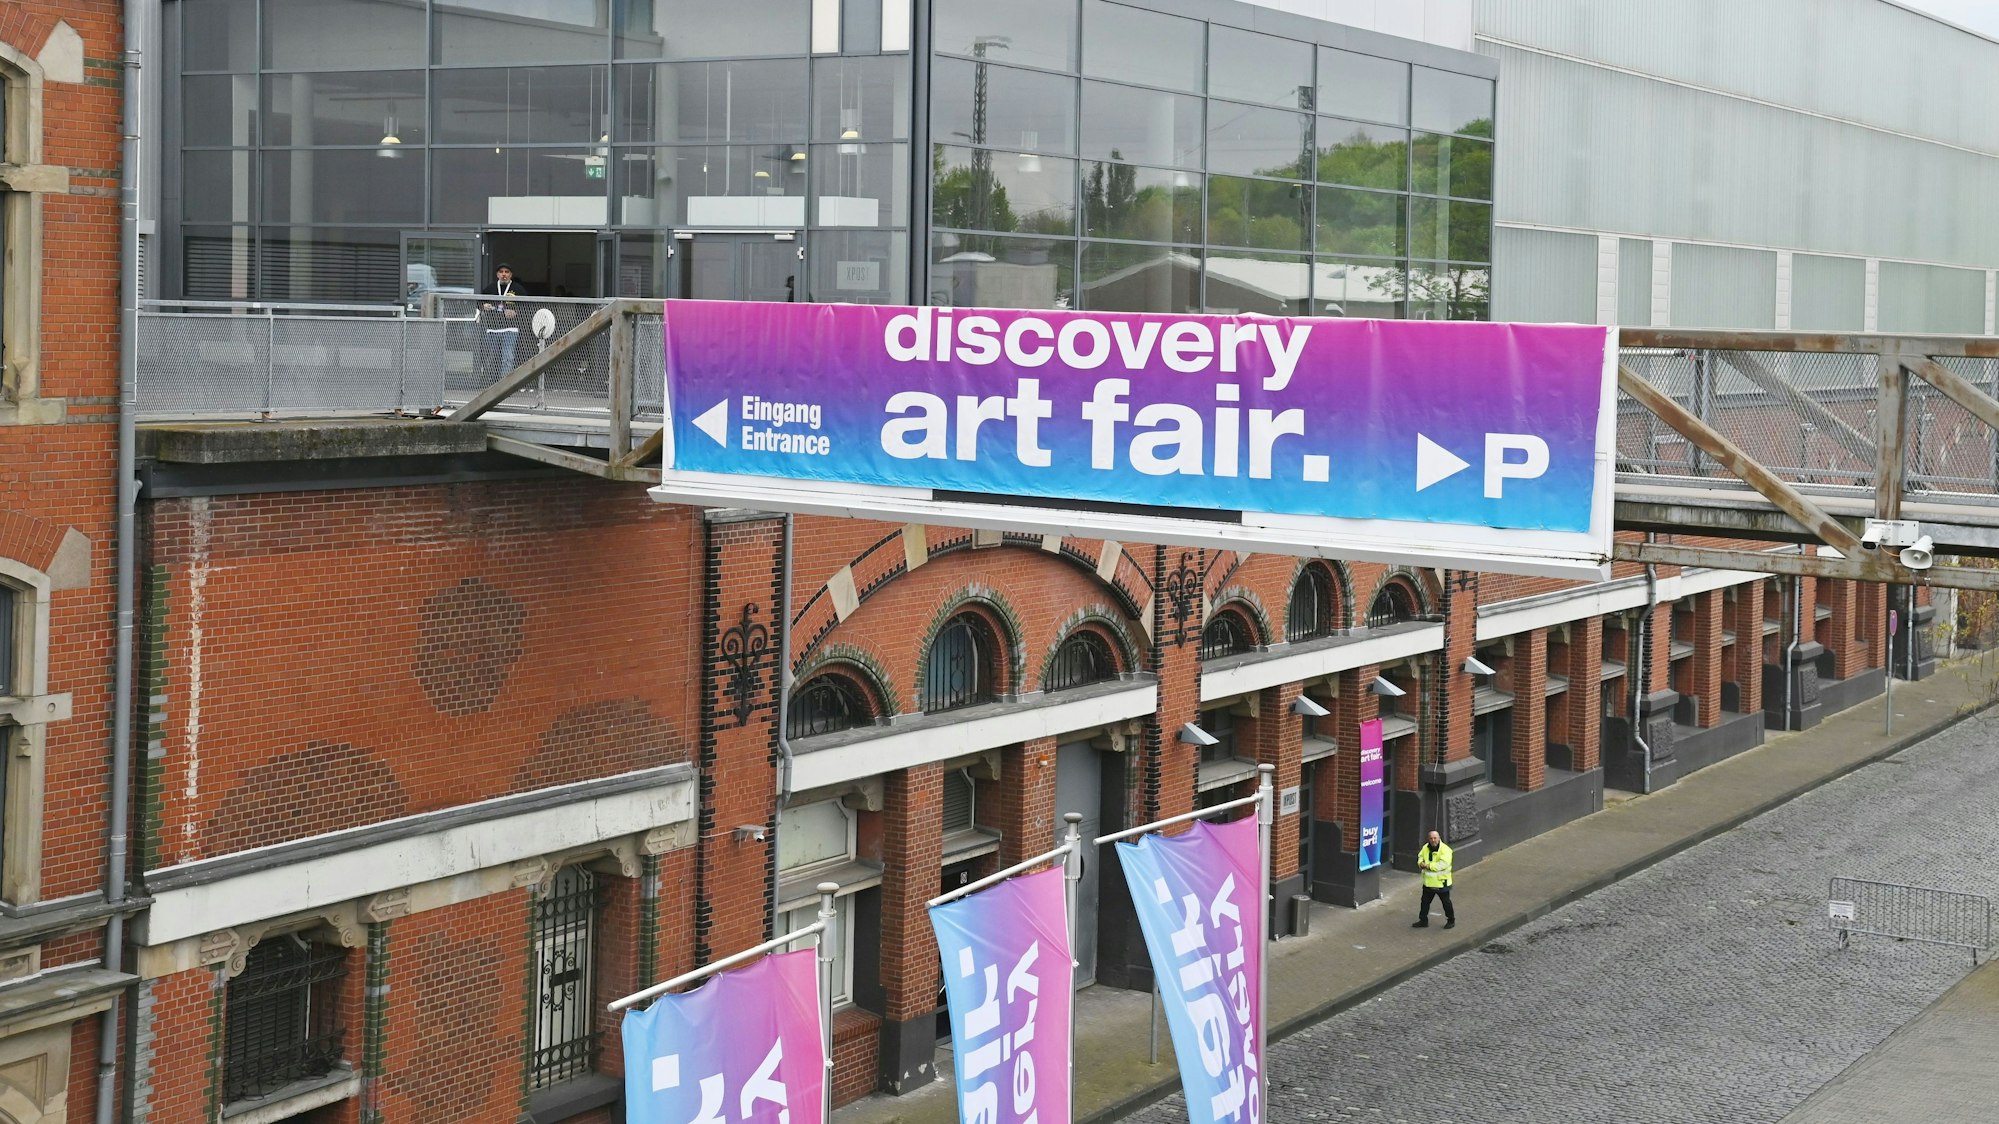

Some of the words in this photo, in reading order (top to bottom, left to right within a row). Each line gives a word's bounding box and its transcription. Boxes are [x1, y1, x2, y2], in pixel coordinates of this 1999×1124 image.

[884, 307, 1312, 391] discovery
[742, 395, 821, 430] Eingang
[881, 378, 1052, 467] art
[1082, 378, 1330, 482] fair.
[742, 425, 830, 456] Entrance
[1484, 433, 1550, 499] P
[1363, 826, 1379, 837] buy
